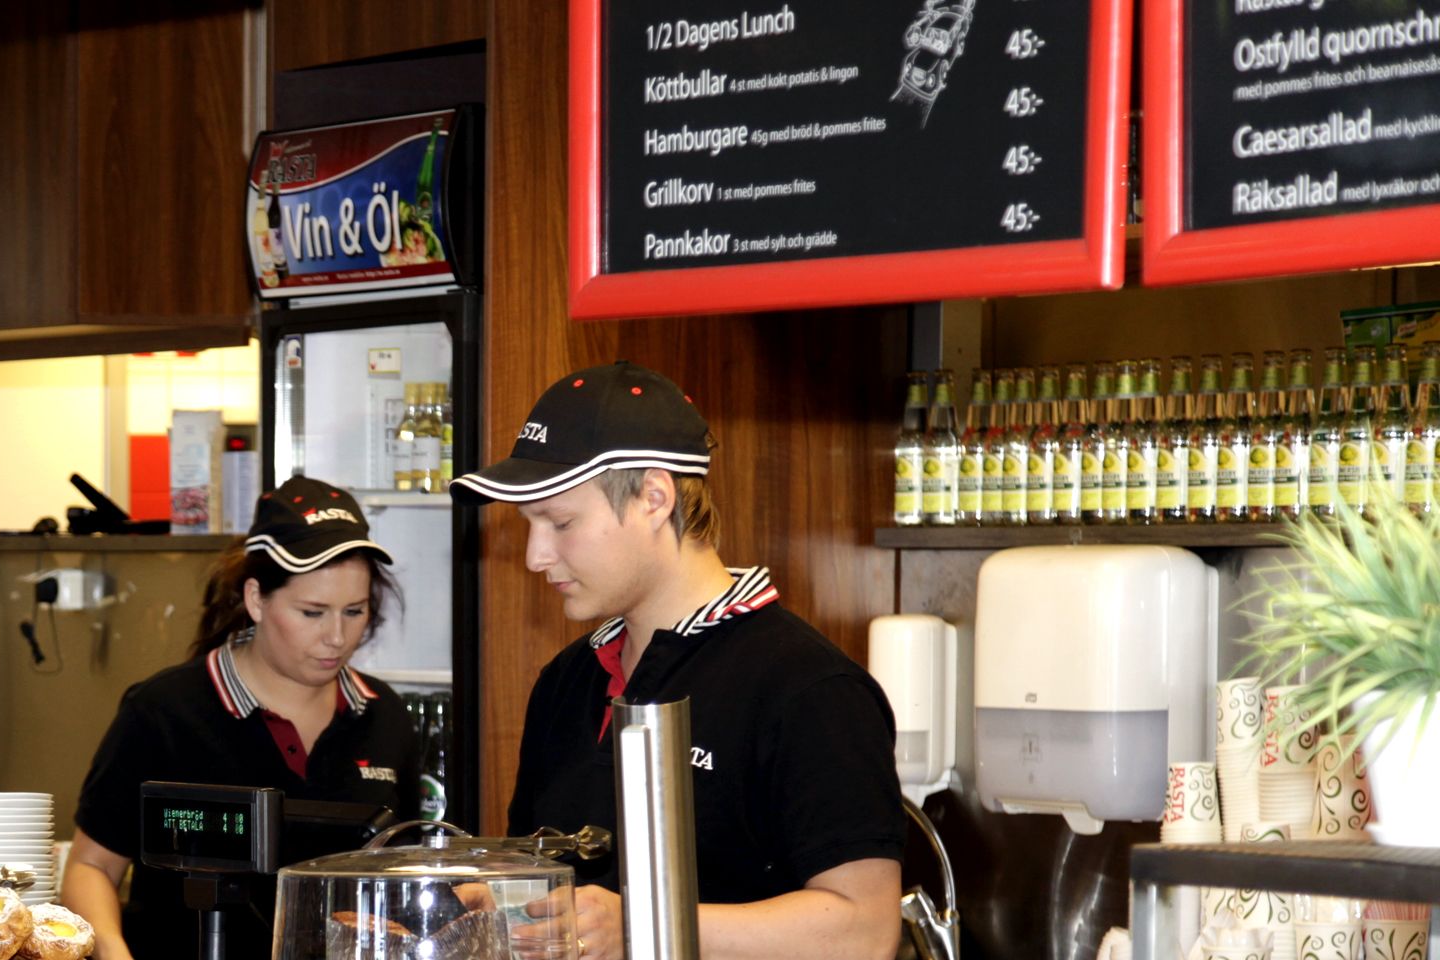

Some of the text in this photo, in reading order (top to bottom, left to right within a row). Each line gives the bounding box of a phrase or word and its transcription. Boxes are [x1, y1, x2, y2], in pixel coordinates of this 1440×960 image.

[647, 5, 795, 50] 1/2 Dagens Lunch
[1006, 28, 1045, 59] 45:-
[1234, 26, 1320, 72] Ostfylld
[644, 65, 859, 103] Köttbullar 4 st med kokt potatis & lingon
[1234, 80, 1263, 101] med
[1264, 76, 1312, 99] pommes
[1313, 70, 1343, 90] frites
[1344, 66, 1366, 85] och
[1004, 86, 1044, 117] 45:-
[644, 117, 887, 156] Hamburgare 45g med bröd & pommes frites
[1233, 107, 1373, 158] Caesarsallad
[1374, 118, 1402, 138] med
[1002, 145, 1042, 175] 45:-
[644, 177, 816, 207] Grillkorv 1 st med pommes frites
[1232, 170, 1338, 215] Räksallad
[1340, 181, 1370, 202] med
[284, 182, 403, 260] Vin & Öl
[1000, 203, 1040, 233] 45:-
[644, 228, 838, 259] Pannkakor 3 st med sylt och grädde
[517, 421, 548, 444] STA
[1170, 766, 1186, 824] RASTA
[163, 818, 177, 829] ATT
[179, 820, 204, 832] BETALA
